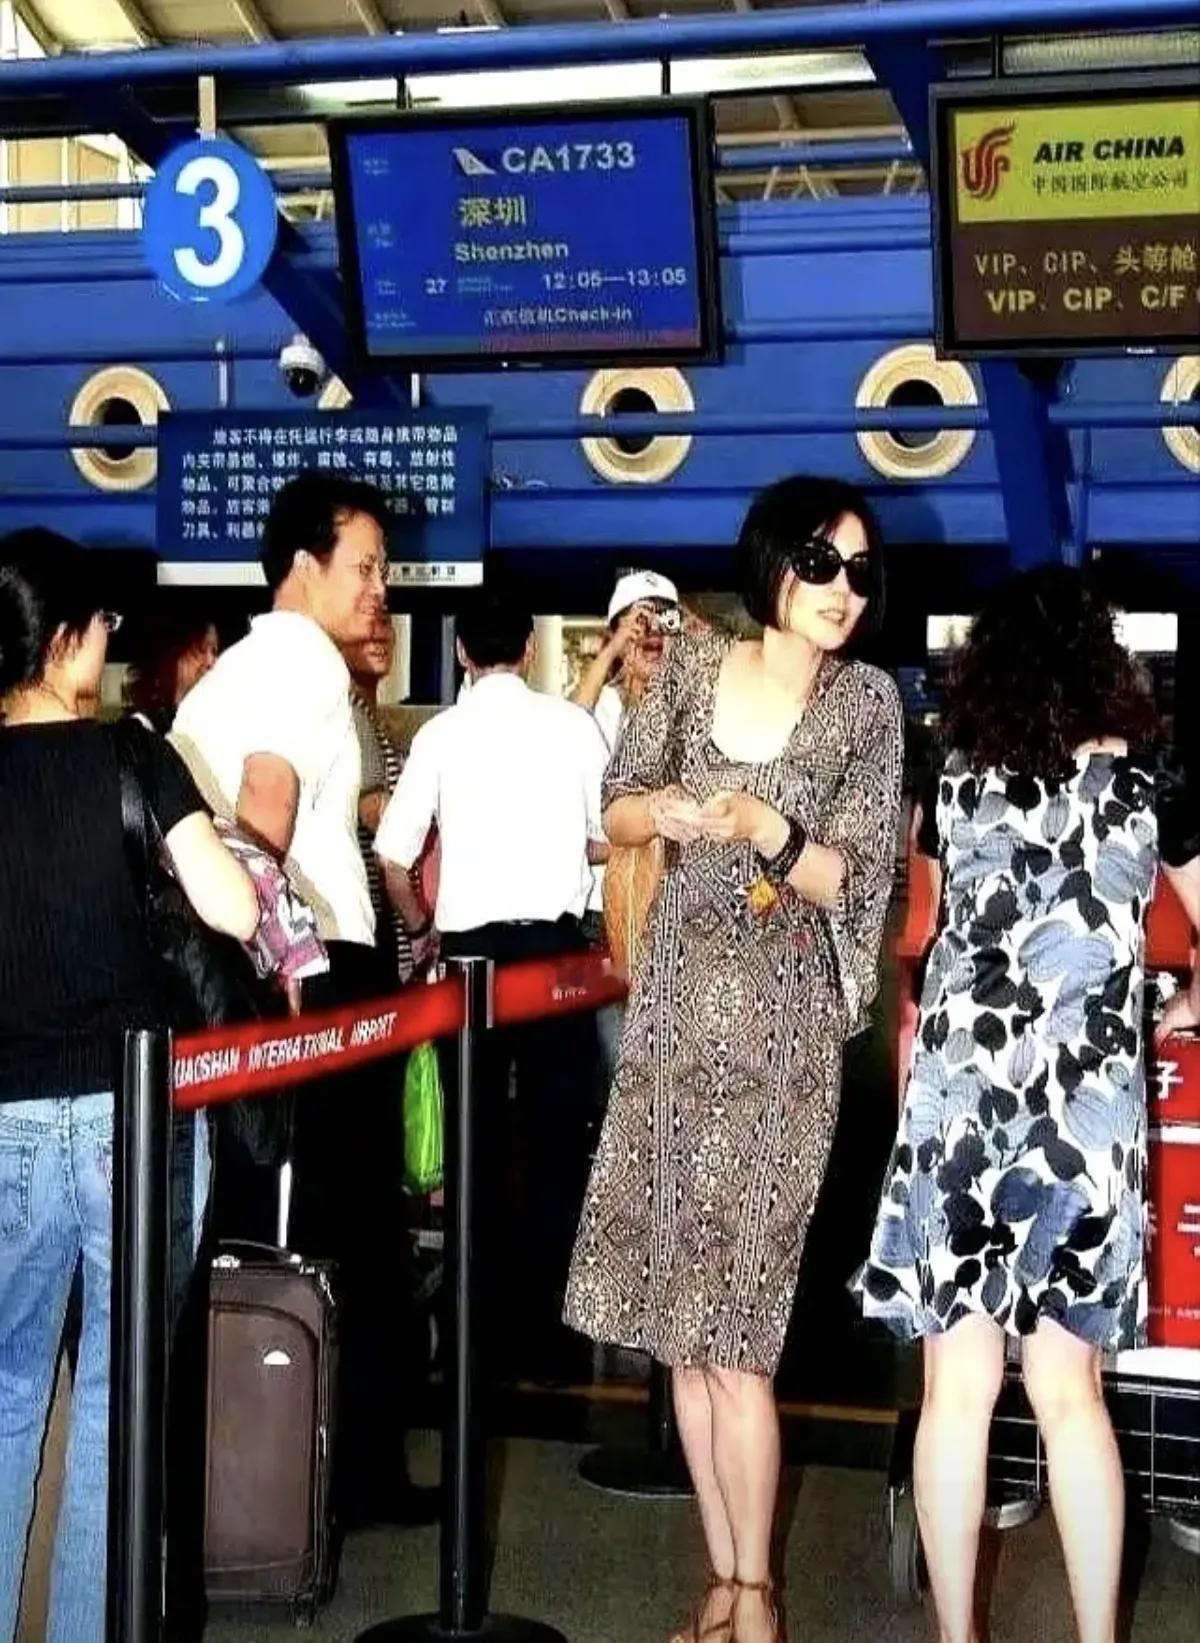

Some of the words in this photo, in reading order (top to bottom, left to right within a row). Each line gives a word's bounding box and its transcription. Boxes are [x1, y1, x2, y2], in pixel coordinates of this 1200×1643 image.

[502, 141, 635, 173] CA1733
[1034, 141, 1084, 164] AIR
[1093, 135, 1185, 161] CHINA
[174, 156, 245, 288] 3
[459, 194, 527, 227] 深圳
[454, 242, 569, 262] Shenzhen
[1141, 284, 1186, 309] C/F
